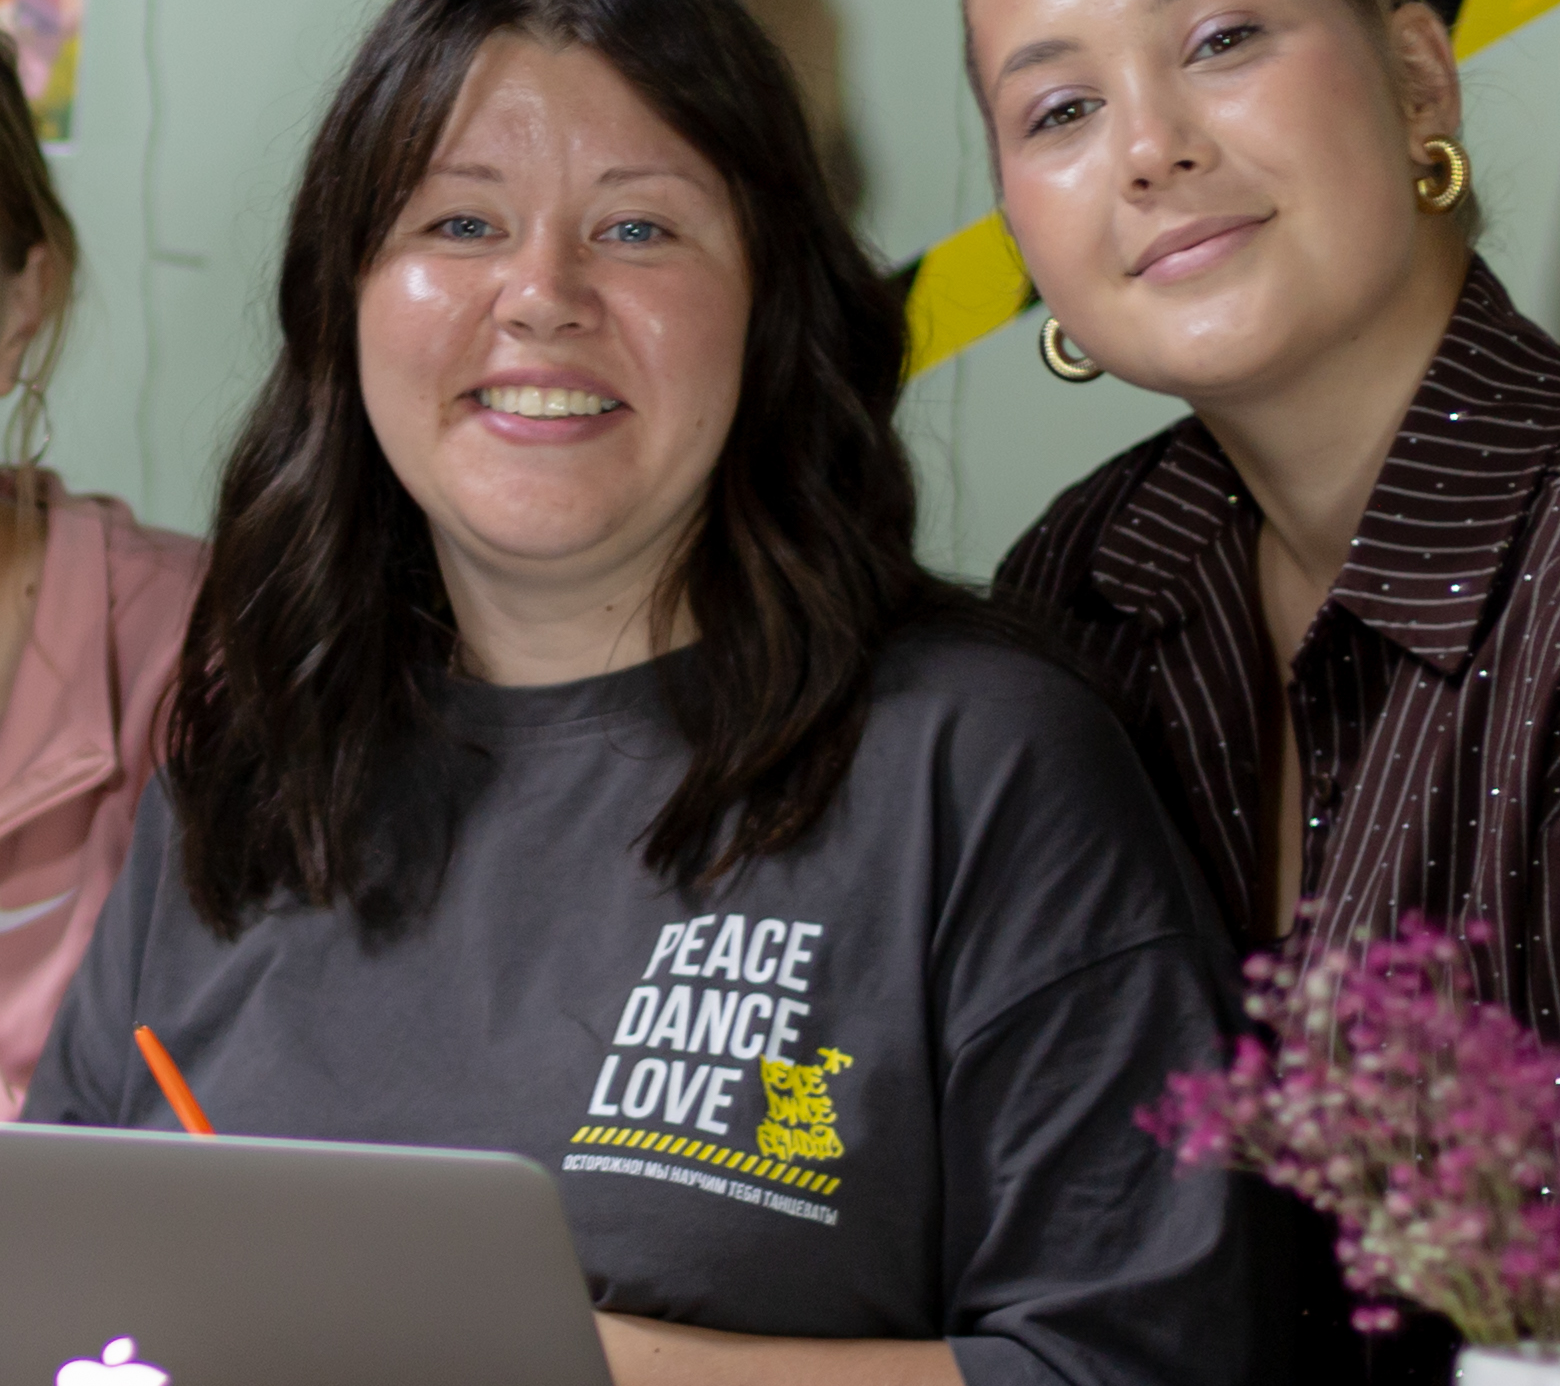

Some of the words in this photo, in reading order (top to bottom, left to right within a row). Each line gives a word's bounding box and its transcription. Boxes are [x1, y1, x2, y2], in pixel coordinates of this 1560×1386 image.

[641, 914, 824, 992] PEACE
[612, 984, 811, 1067] DANCE
[587, 1054, 743, 1136] LOVE
[669, 1165, 728, 1196] НАУЧИМ
[727, 1179, 762, 1206] ТЕБЯ
